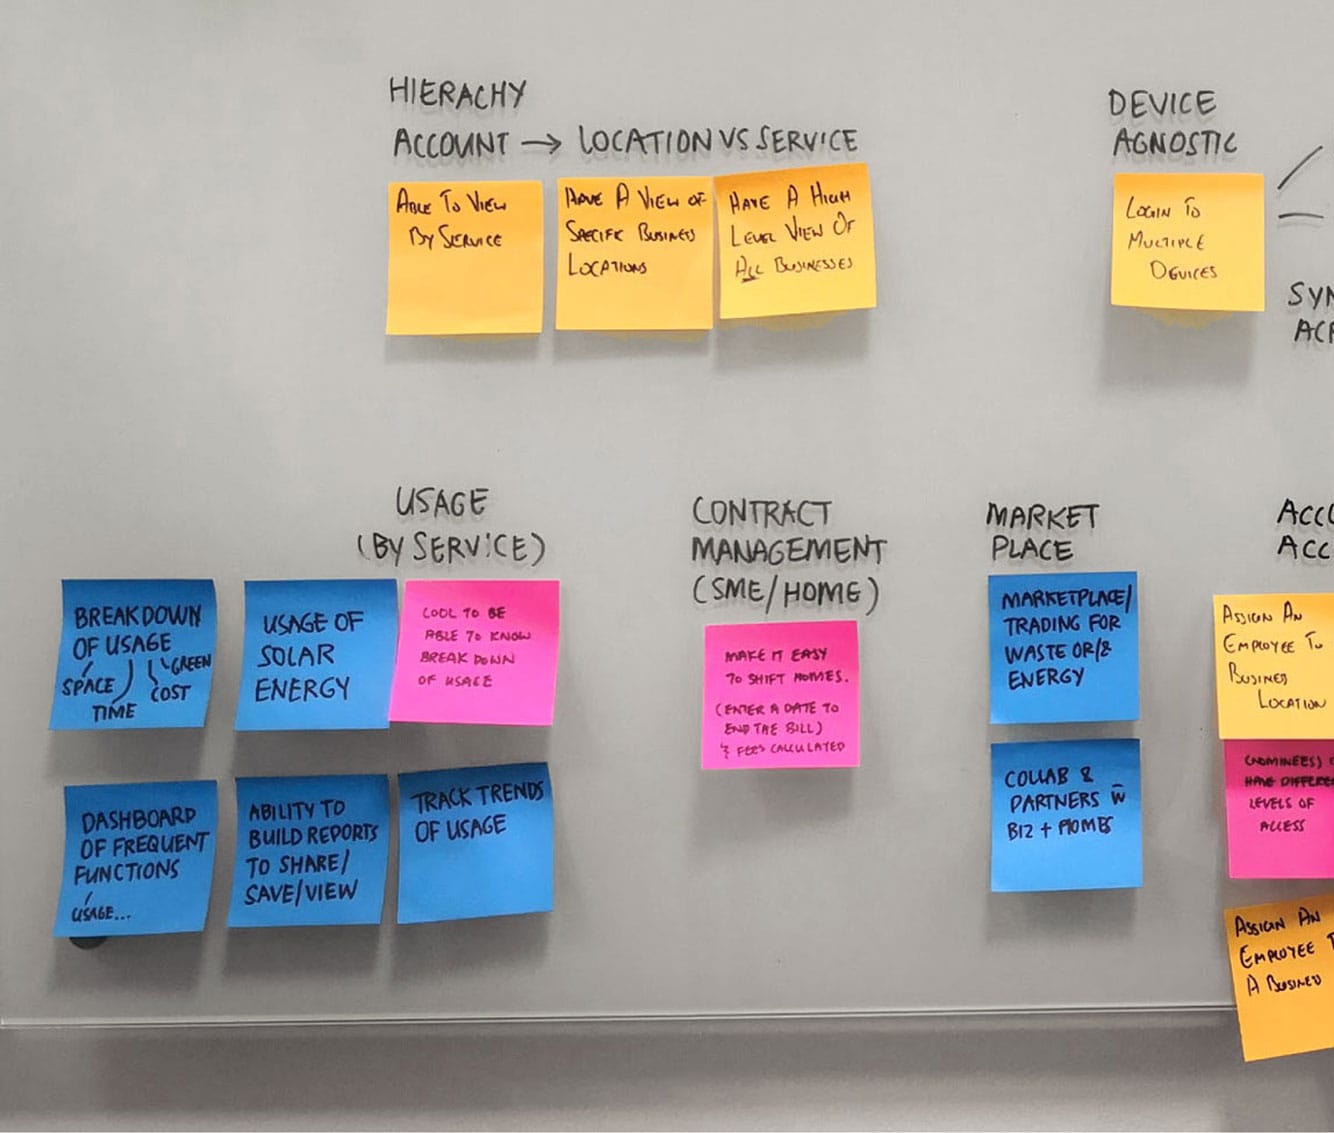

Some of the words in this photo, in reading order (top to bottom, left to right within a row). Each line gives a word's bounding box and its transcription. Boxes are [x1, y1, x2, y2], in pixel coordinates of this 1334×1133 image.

[390, 77, 526, 110] HIERACHY
[1109, 89, 1216, 118] DEVICE
[394, 128, 509, 157] ACCOUNT
[578, 125, 710, 153] LOCATION
[719, 128, 749, 150] VS
[755, 127, 857, 152] SERVICE
[1113, 128, 1237, 155] AGNOSTIC
[397, 488, 488, 516] USAGE
[693, 496, 832, 528] CONTRACT
[986, 503, 1099, 530] MARKET
[358, 533, 402, 564] (BY
[413, 532, 545, 566] SERVICE)
[692, 535, 887, 565] MANAGEMENT
[992, 535, 1073, 560] PLACE
[1002, 584, 1132, 613] MARKETPLACE/
[264, 613, 329, 635] USAGE
[334, 612, 364, 632] OF
[463, 608, 479, 619] TO
[1003, 615, 1080, 636] TRADING
[1090, 614, 1121, 632] FOR
[74, 638, 97, 659] OF
[106, 635, 171, 653] USAGE
[491, 632, 531, 642] KNOW
[172, 654, 211, 673] GREEN
[258, 645, 335, 667] SOLAR
[725, 650, 765, 662] MAKE
[772, 650, 783, 660] IT
[791, 648, 827, 660] EASY
[1005, 644, 1066, 664] WASTE
[63, 676, 113, 696] SPACE
[256, 677, 350, 701] ENERGY
[419, 675, 437, 686] OF
[749, 673, 785, 684] SHIFT
[1009, 668, 1084, 690] ENERGY
[151, 685, 191, 701] COST
[92, 705, 137, 721] TIME
[784, 702, 816, 714] DATE
[822, 703, 839, 713] TO
[1005, 767, 1069, 788] COLLAB
[410, 786, 470, 811] TRACK
[480, 781, 544, 802] TRENDS
[1011, 792, 1099, 813] PARTNERS
[1250, 798, 1291, 808] LEVELS
[1298, 798, 1314, 808] OF
[81, 807, 196, 833] DASHBOARD
[250, 802, 314, 821] ABILITY
[324, 800, 345, 818] TO
[250, 827, 302, 848] BUILD
[308, 824, 379, 844] REPORTS
[416, 822, 439, 842] OF
[448, 814, 507, 840] USAGE
[1260, 820, 1305, 831] ACCESS
[81, 839, 108, 859] OF
[113, 832, 210, 856] FREQUENT
[75, 859, 179, 884] FUNCTIONS
[247, 857, 270, 877] TO
[279, 850, 350, 873] SHARE/
